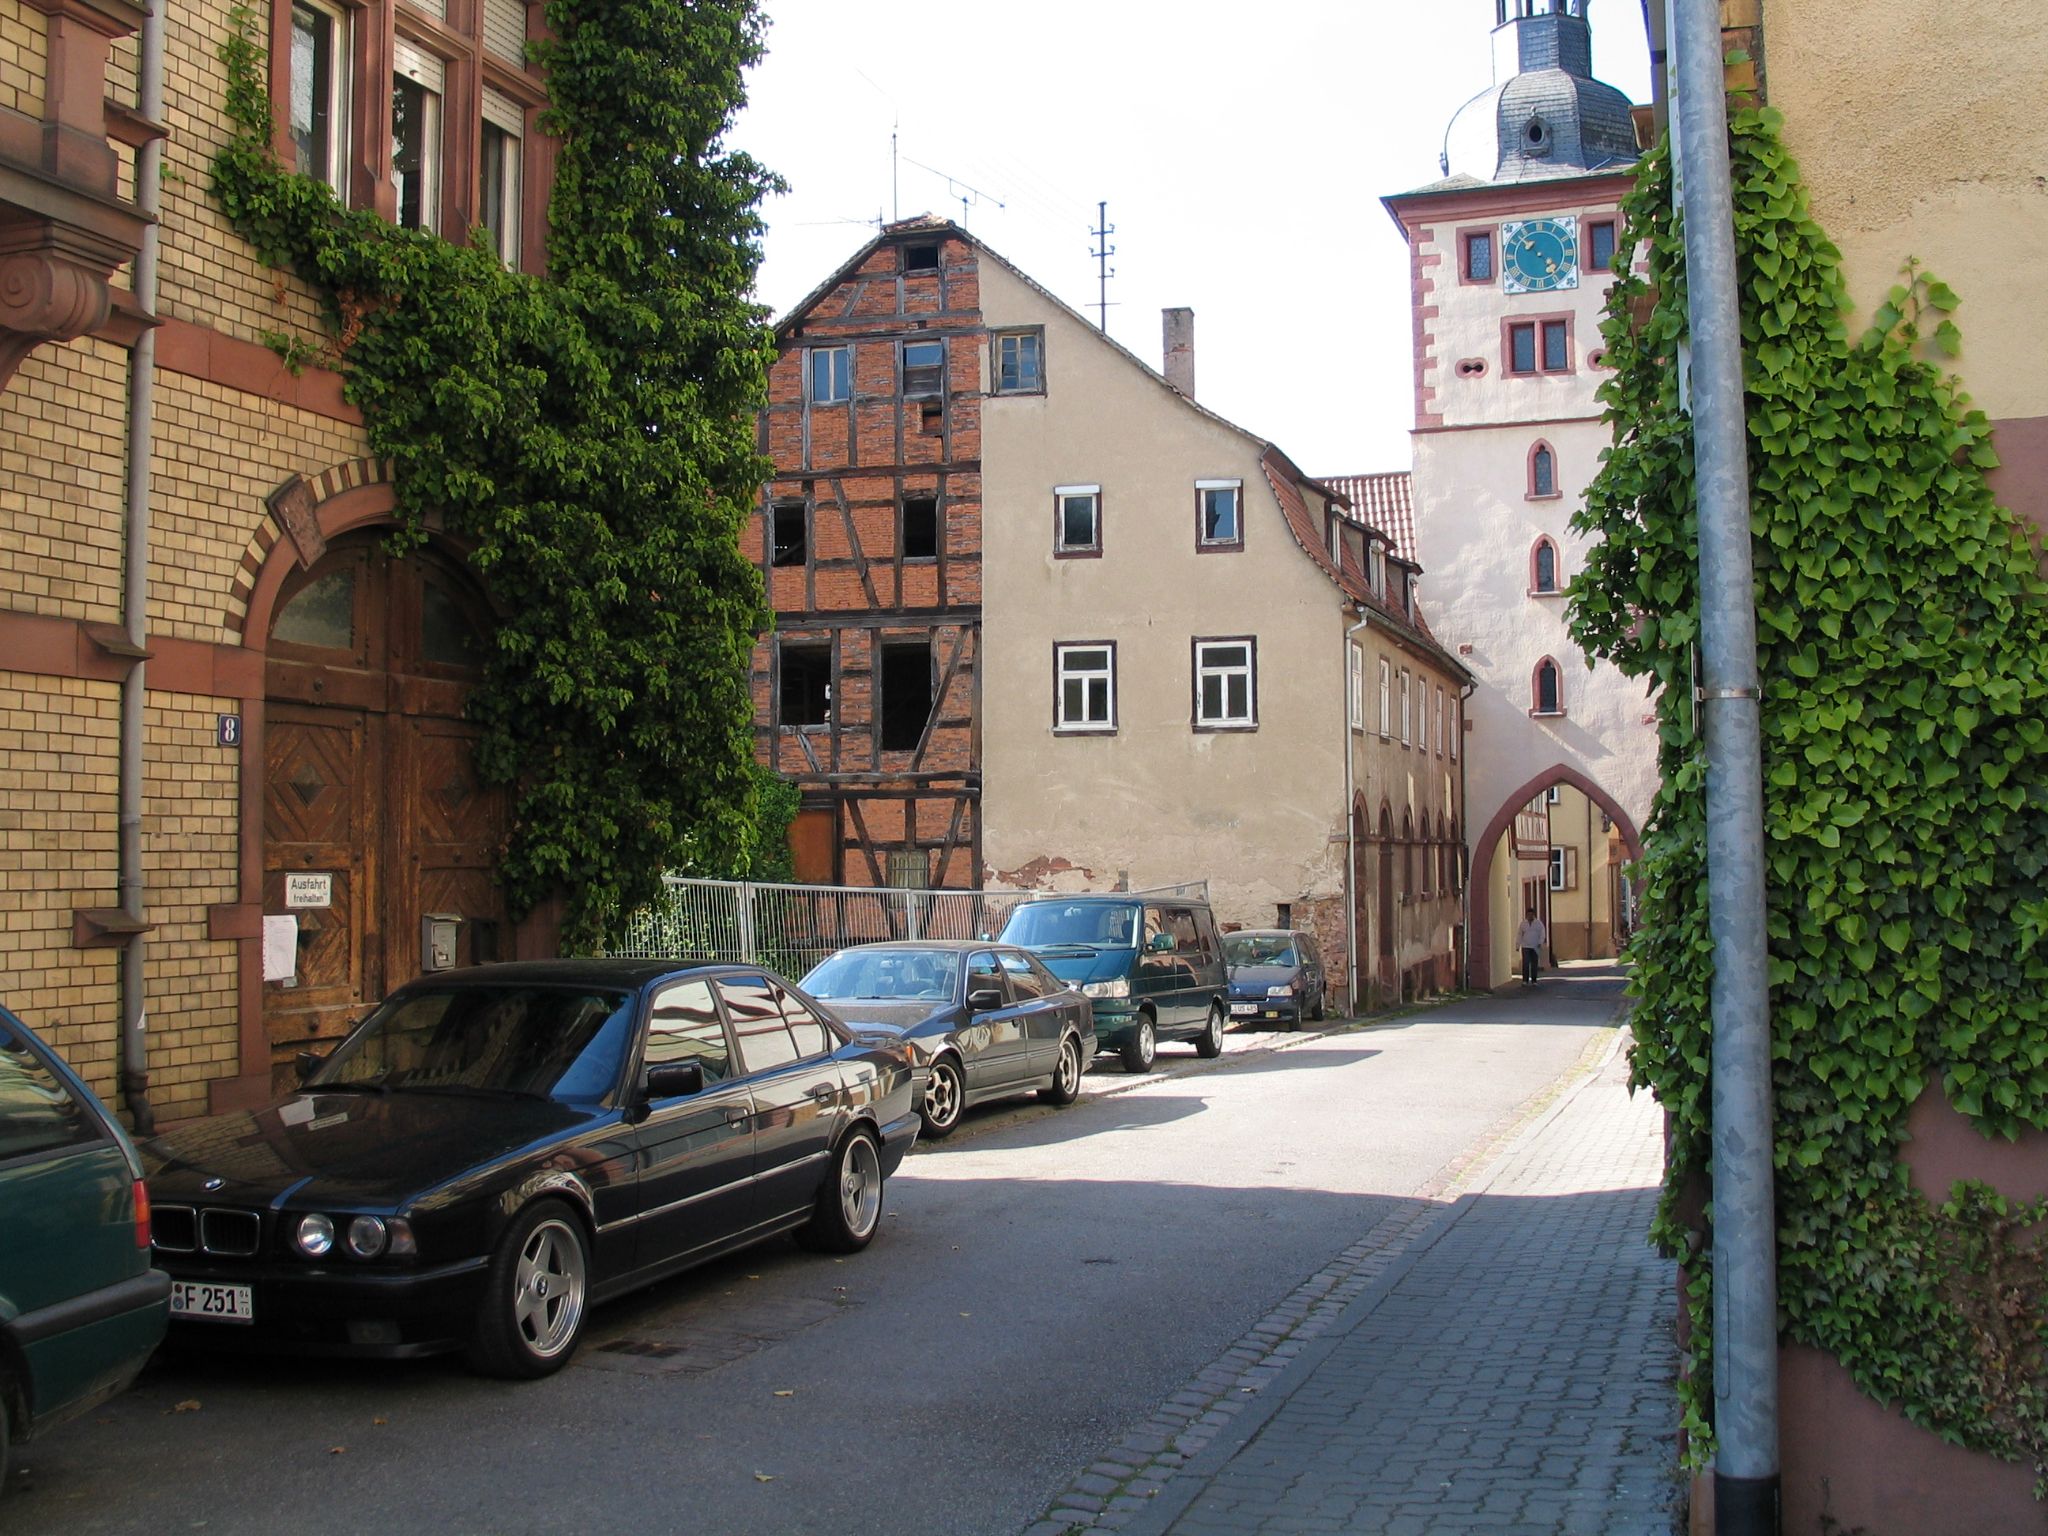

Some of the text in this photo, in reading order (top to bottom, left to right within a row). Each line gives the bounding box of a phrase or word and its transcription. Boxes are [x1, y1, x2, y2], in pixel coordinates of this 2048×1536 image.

[225, 718, 235, 742] 8
[291, 878, 327, 890] Ausfahrt
[293, 894, 324, 903] freihalten
[185, 1286, 237, 1314] F 251
